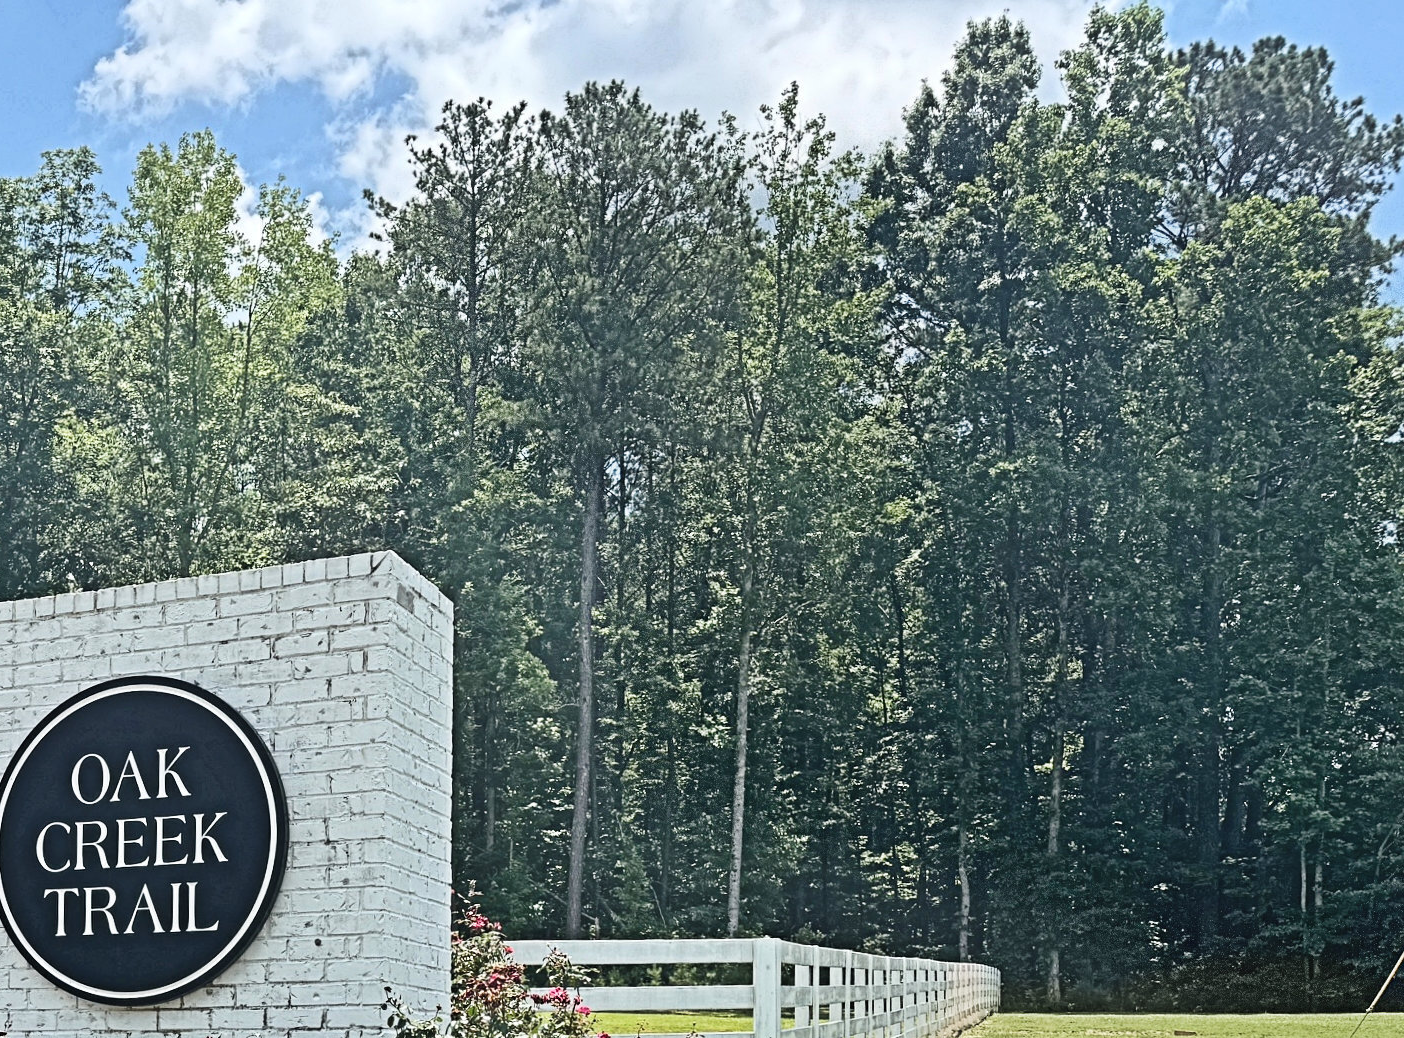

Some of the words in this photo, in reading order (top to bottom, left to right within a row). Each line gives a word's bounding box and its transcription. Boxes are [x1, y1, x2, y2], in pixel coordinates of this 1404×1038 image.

[71, 746, 191, 805] OAK
[35, 811, 228, 873] CREEK
[43, 881, 220, 937] TRAIL
